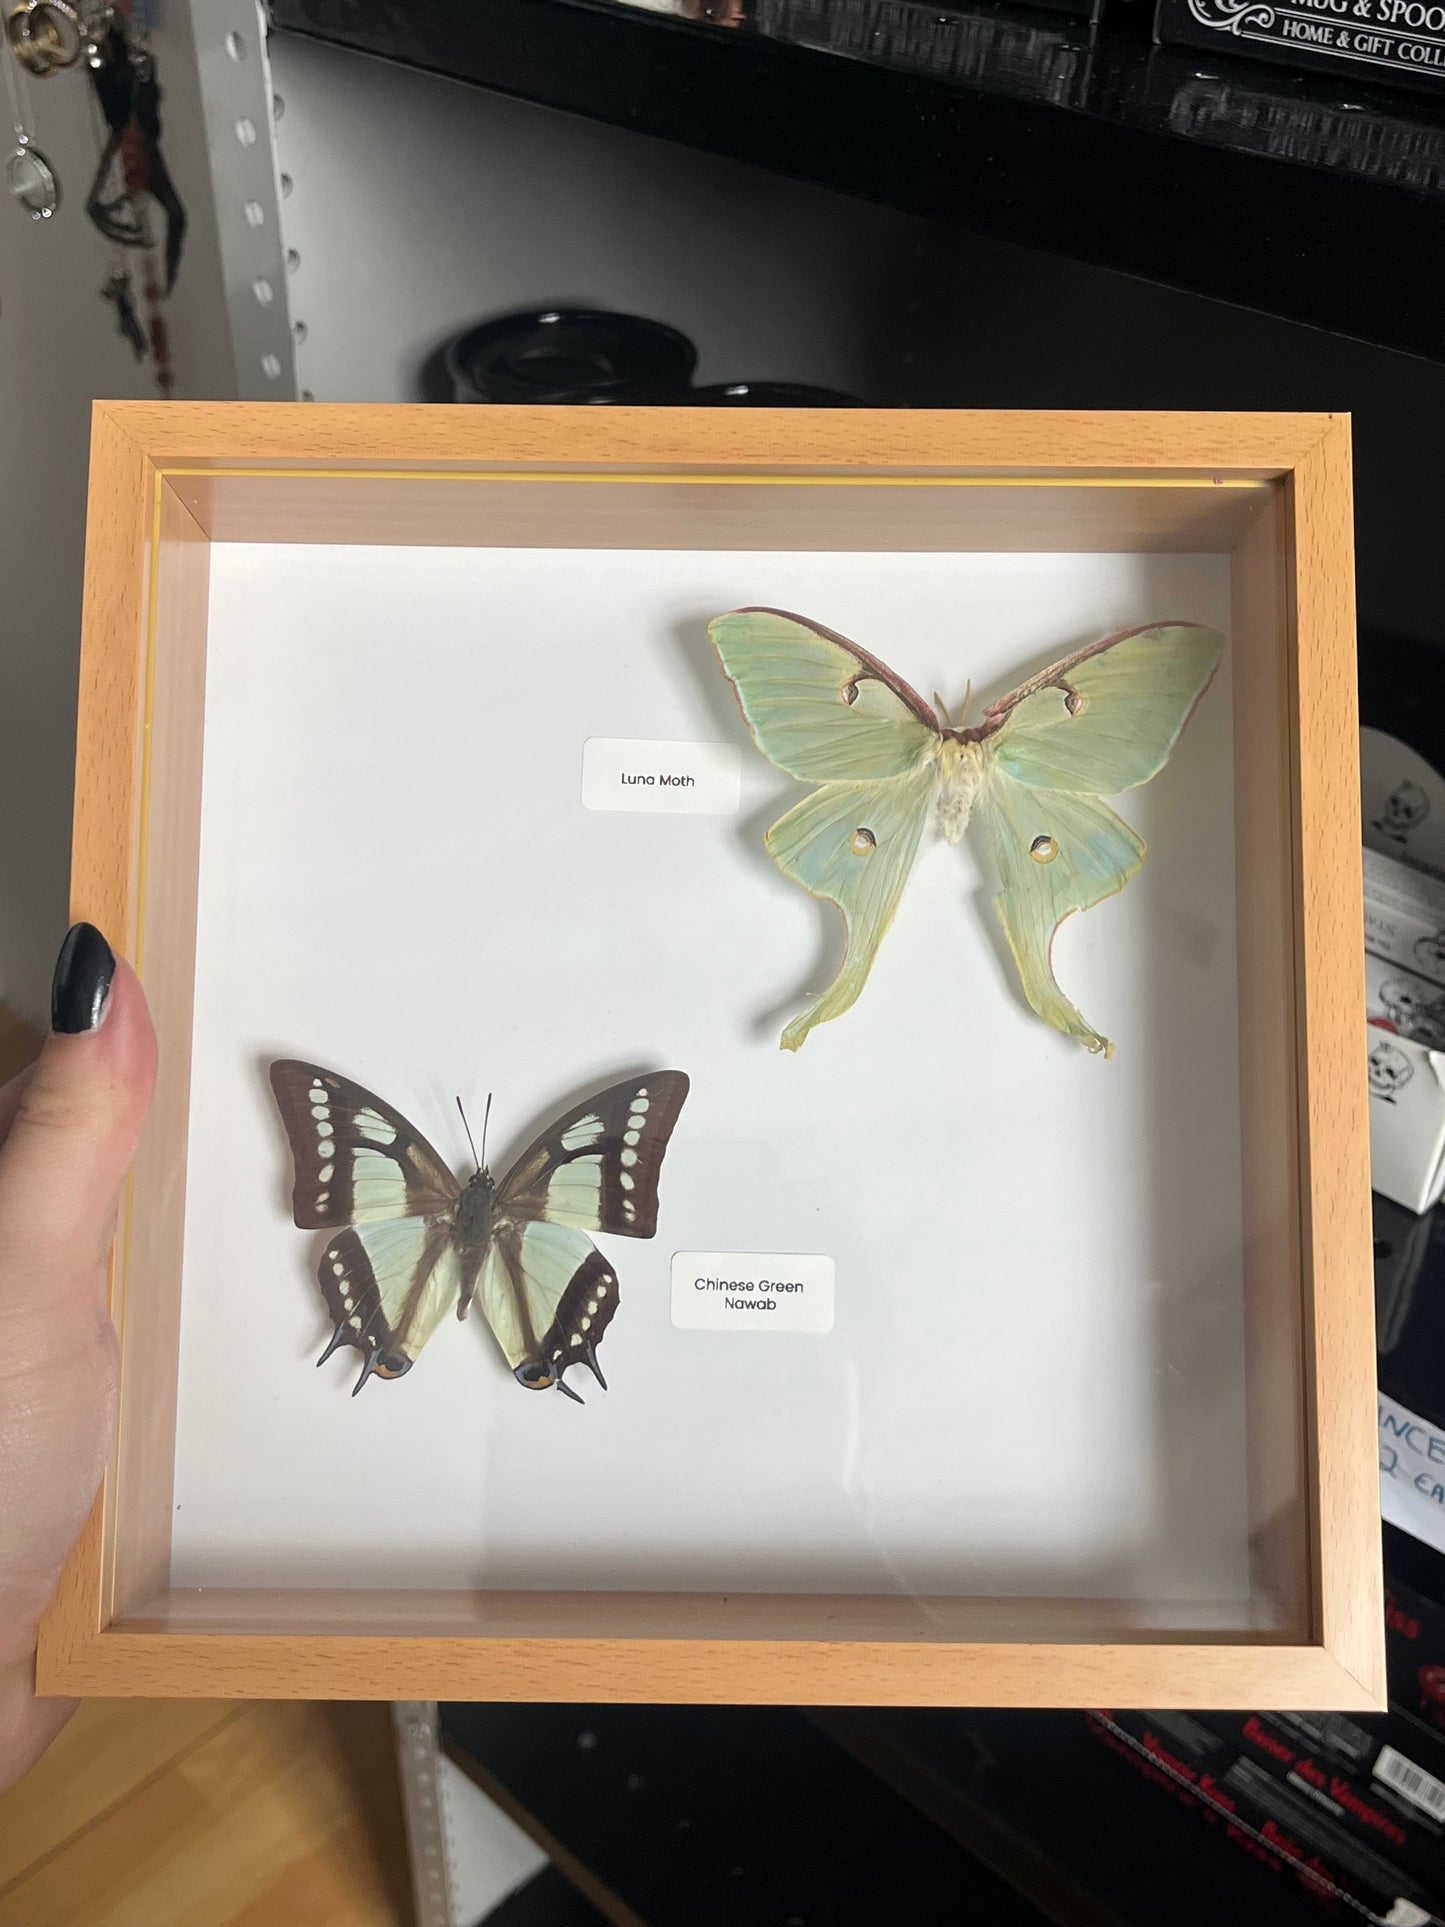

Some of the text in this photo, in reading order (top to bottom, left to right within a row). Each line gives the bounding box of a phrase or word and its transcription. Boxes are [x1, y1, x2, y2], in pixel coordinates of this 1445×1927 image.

[1352, 0, 1371, 18] &
[1376, 0, 1445, 31] SPOO
[1282, 19, 1445, 67] HOME & GIFT COLL
[621, 772, 695, 787] Luna Moth
[694, 1277, 804, 1293] Chinese Green
[724, 1296, 777, 1311] Nawab
